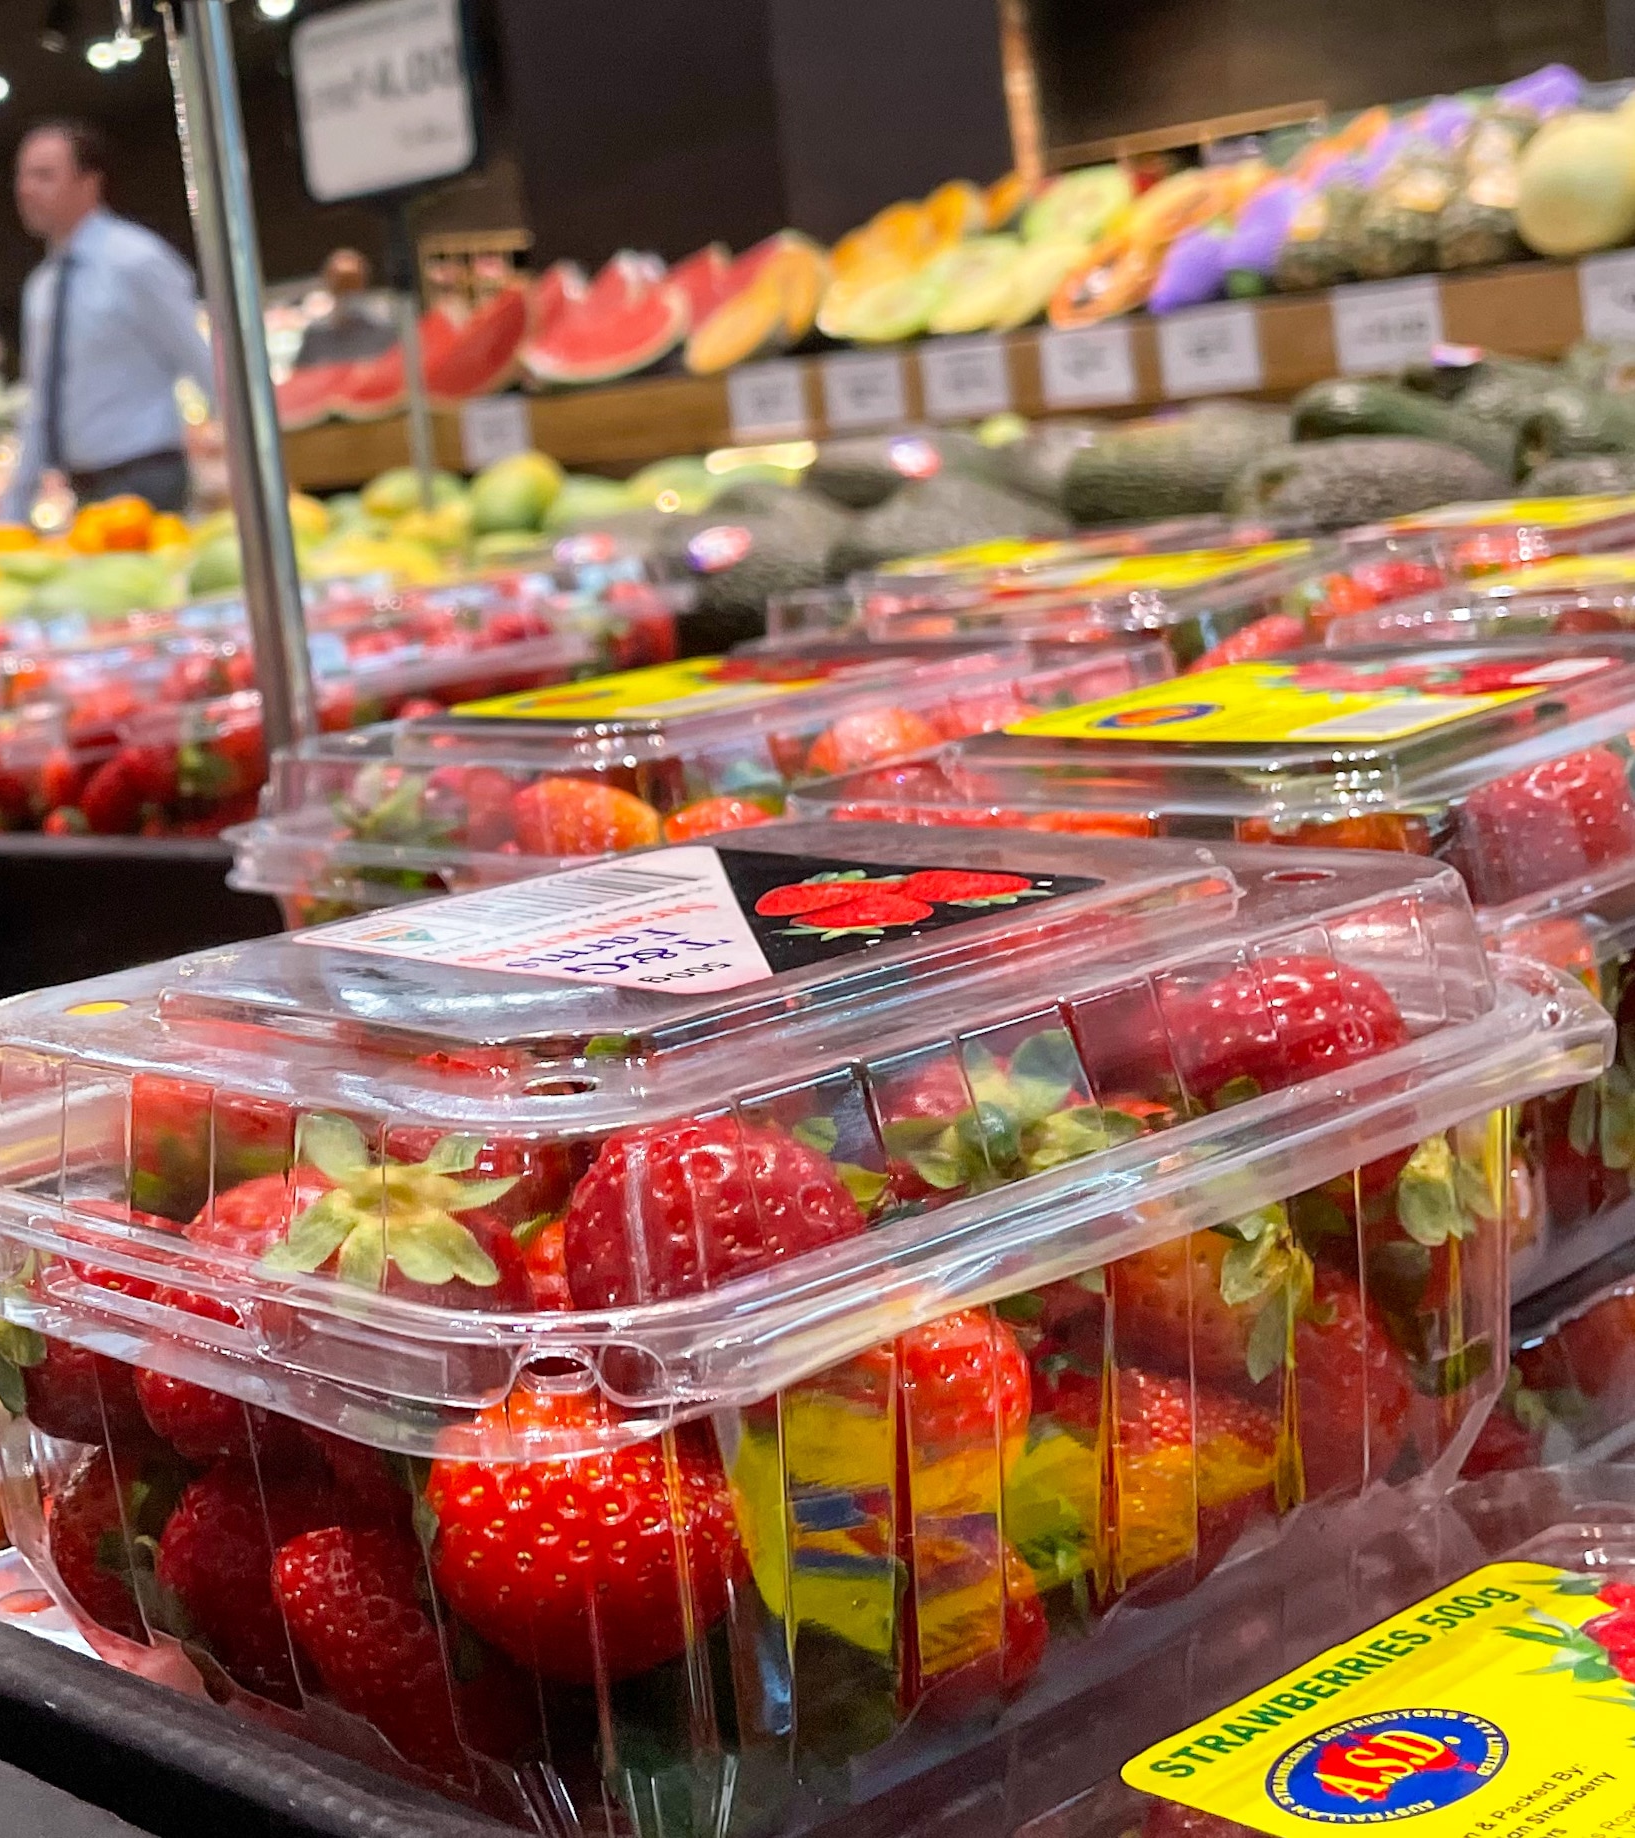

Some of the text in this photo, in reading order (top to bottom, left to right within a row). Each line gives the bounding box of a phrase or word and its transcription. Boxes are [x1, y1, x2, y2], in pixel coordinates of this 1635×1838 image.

[458, 902, 719, 963] Strawberries
[506, 928, 682, 969] Farms
[637, 962, 732, 984] 500g
[1149, 1586, 1521, 1778] STRAWBERRIES 500g
[1490, 1781, 1559, 1820] Packed
[1524, 1771, 1617, 1825] Strawberry
